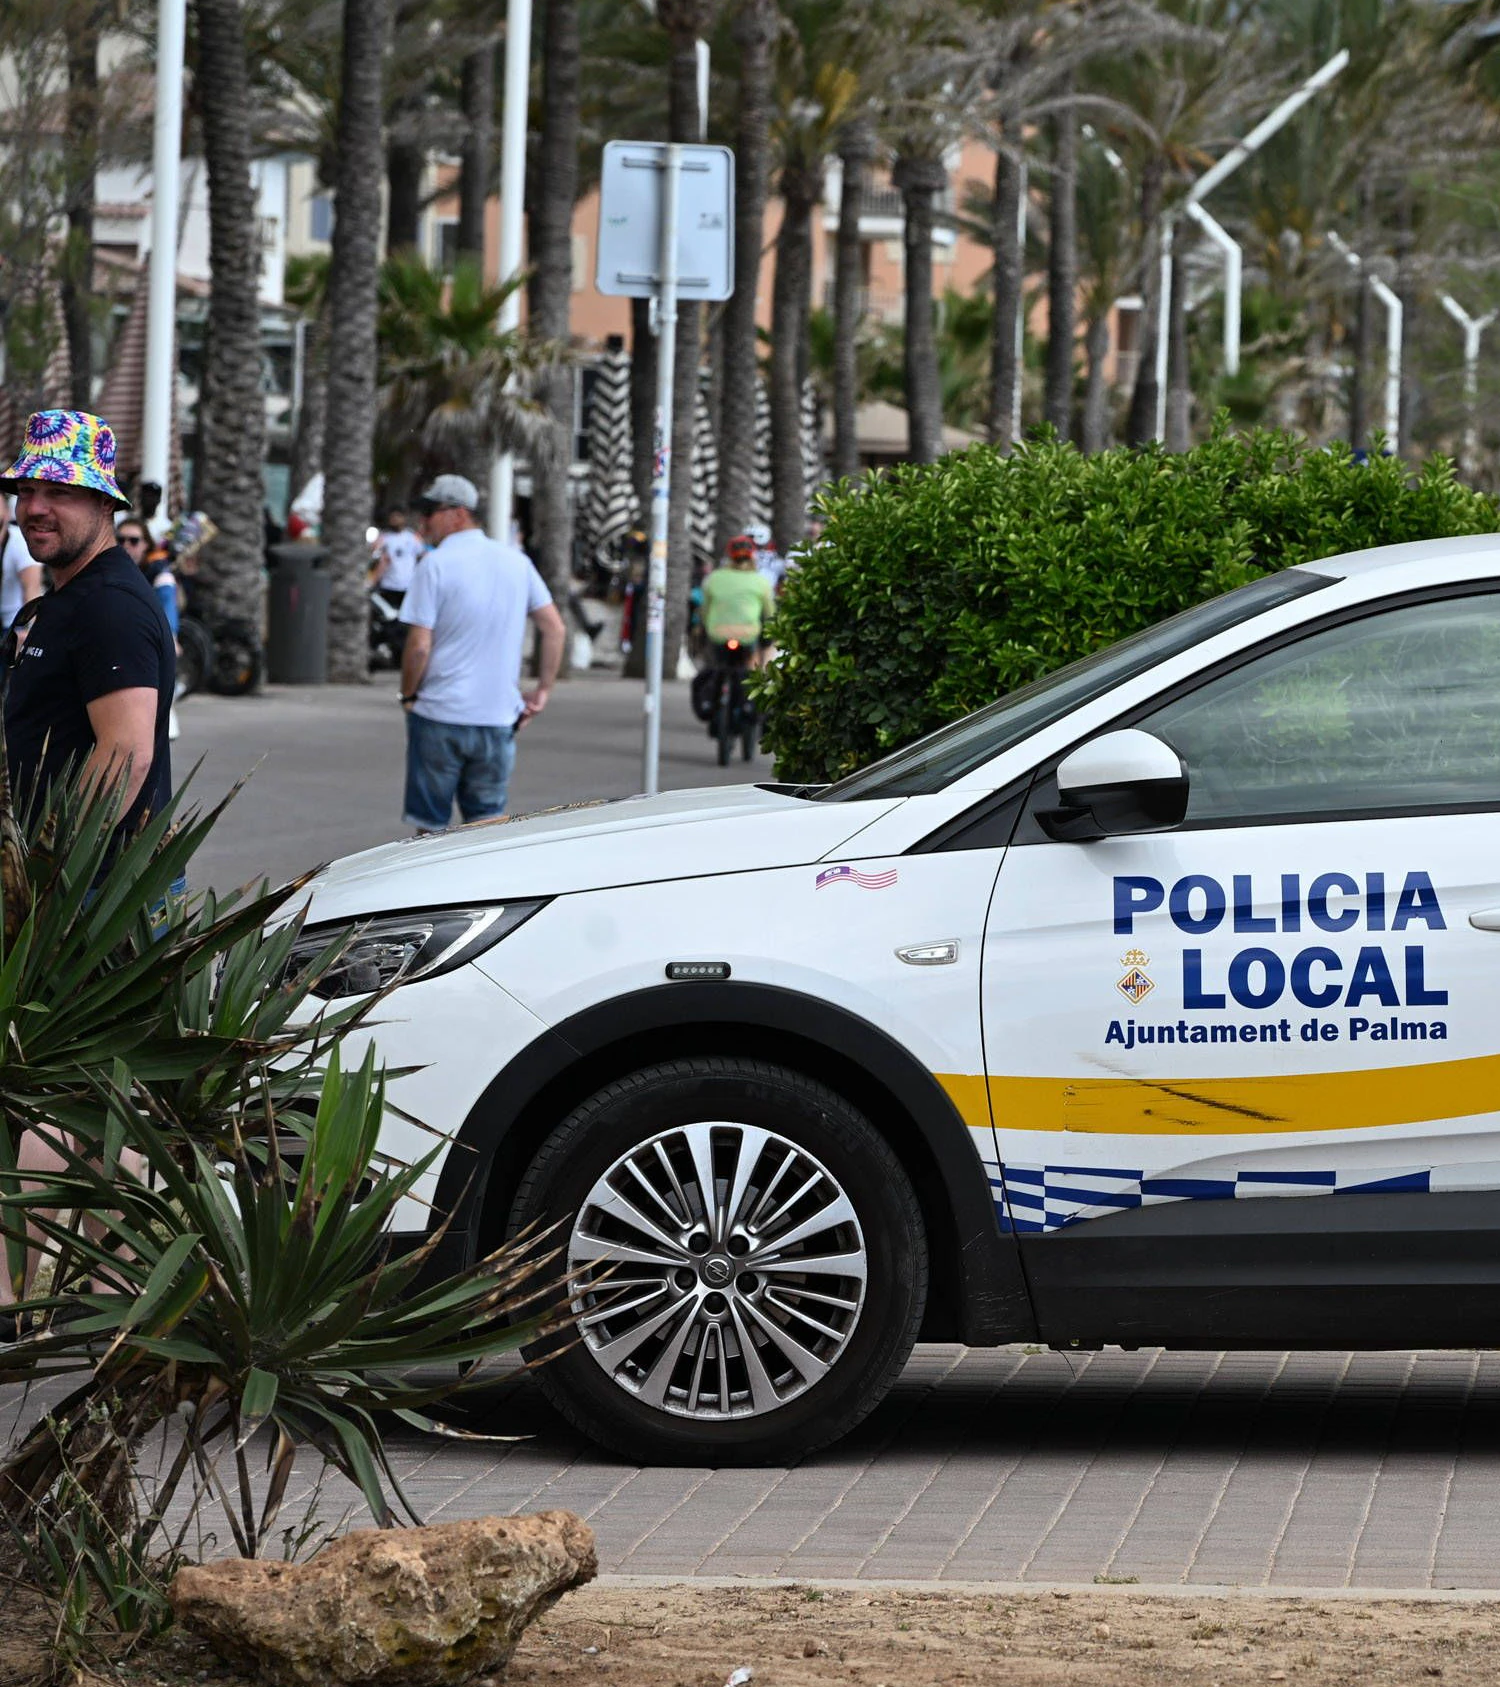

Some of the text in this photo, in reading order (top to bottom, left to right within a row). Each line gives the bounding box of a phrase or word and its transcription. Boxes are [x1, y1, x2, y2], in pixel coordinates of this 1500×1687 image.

[1112, 871, 1448, 935] POLICIA
[1182, 945, 1449, 1010] LOCAL
[1104, 1016, 1448, 1050] Ajuntament de Palma
